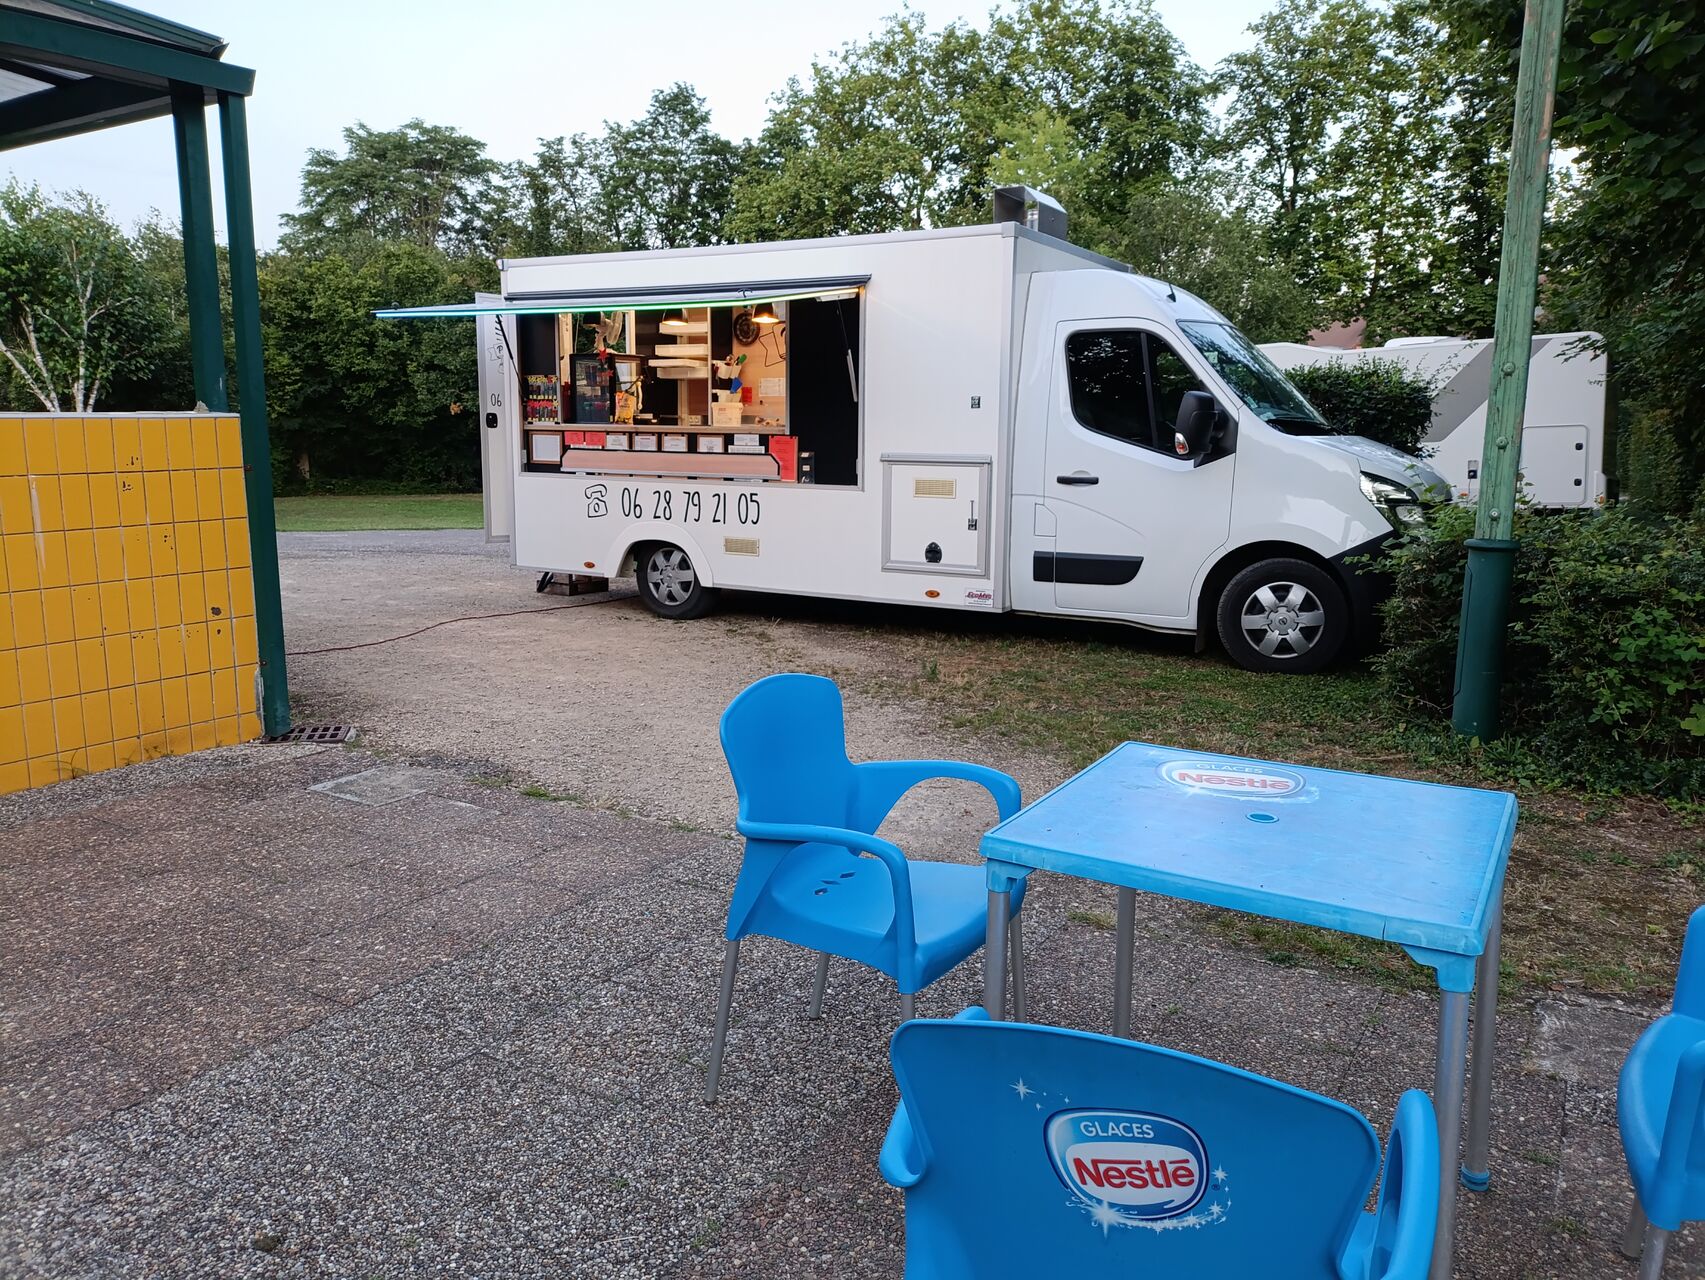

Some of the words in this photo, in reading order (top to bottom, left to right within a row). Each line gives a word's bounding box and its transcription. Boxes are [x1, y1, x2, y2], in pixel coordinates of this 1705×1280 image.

[490, 393, 502, 407] 06
[621, 487, 642, 519] 06
[653, 490, 672, 521] 28
[683, 491, 701, 523] 79
[712, 493, 727, 524] 21
[738, 493, 760, 525] 05
[1196, 763, 1263, 774] GLACES
[1080, 1121, 1155, 1139] GLACES
[1072, 1157, 1195, 1189] Nestlé
